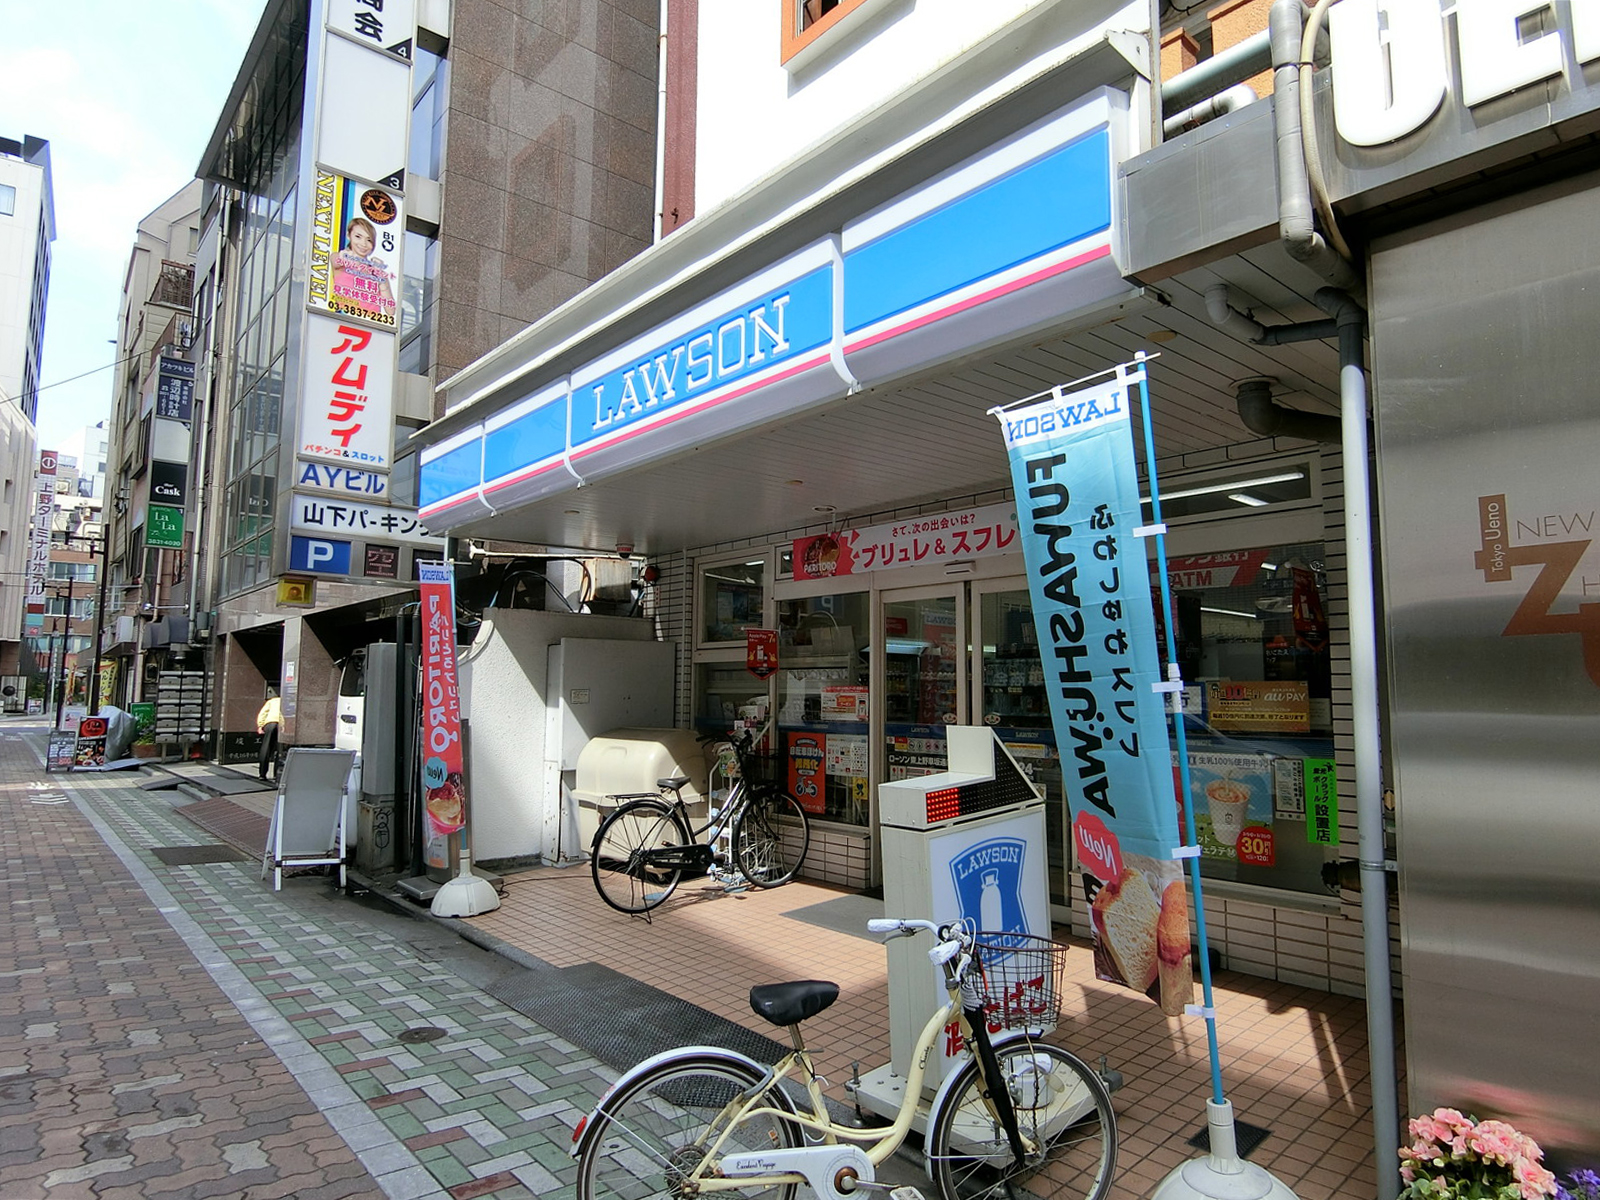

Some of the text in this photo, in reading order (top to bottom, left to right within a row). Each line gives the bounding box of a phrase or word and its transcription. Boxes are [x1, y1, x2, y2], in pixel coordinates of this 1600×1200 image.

[389, 177, 400, 190] 3
[309, 171, 335, 304] NEXT LEVEL
[383, 231, 395, 242] B1
[333, 284, 396, 309] 見学体験受付中
[354, 276, 379, 293] 無料
[591, 291, 791, 431] LAWSON
[327, 324, 373, 448] アムディ
[304, 444, 385, 463] パチンコ&スロット
[154, 485, 181, 497] Cask
[300, 463, 385, 494] AYビル
[154, 511, 170, 522] La
[162, 521, 177, 532] La
[892, 513, 976, 538] さて、次の出会いは?
[1517, 510, 1595, 540] NEW
[30, 482, 52, 596] 上野ターミナルホテル
[862, 523, 1016, 569] ブリュレ&スフレ
[1485, 502, 1506, 573] Tokyo Ueno
[306, 539, 334, 570] P
[803, 562, 837, 573] PARITORO
[1172, 570, 1212, 587] ATM
[1264, 692, 1306, 702] au PAY
[1315, 804, 1330, 842] 設置店
[957, 845, 1021, 882] LAWSON
